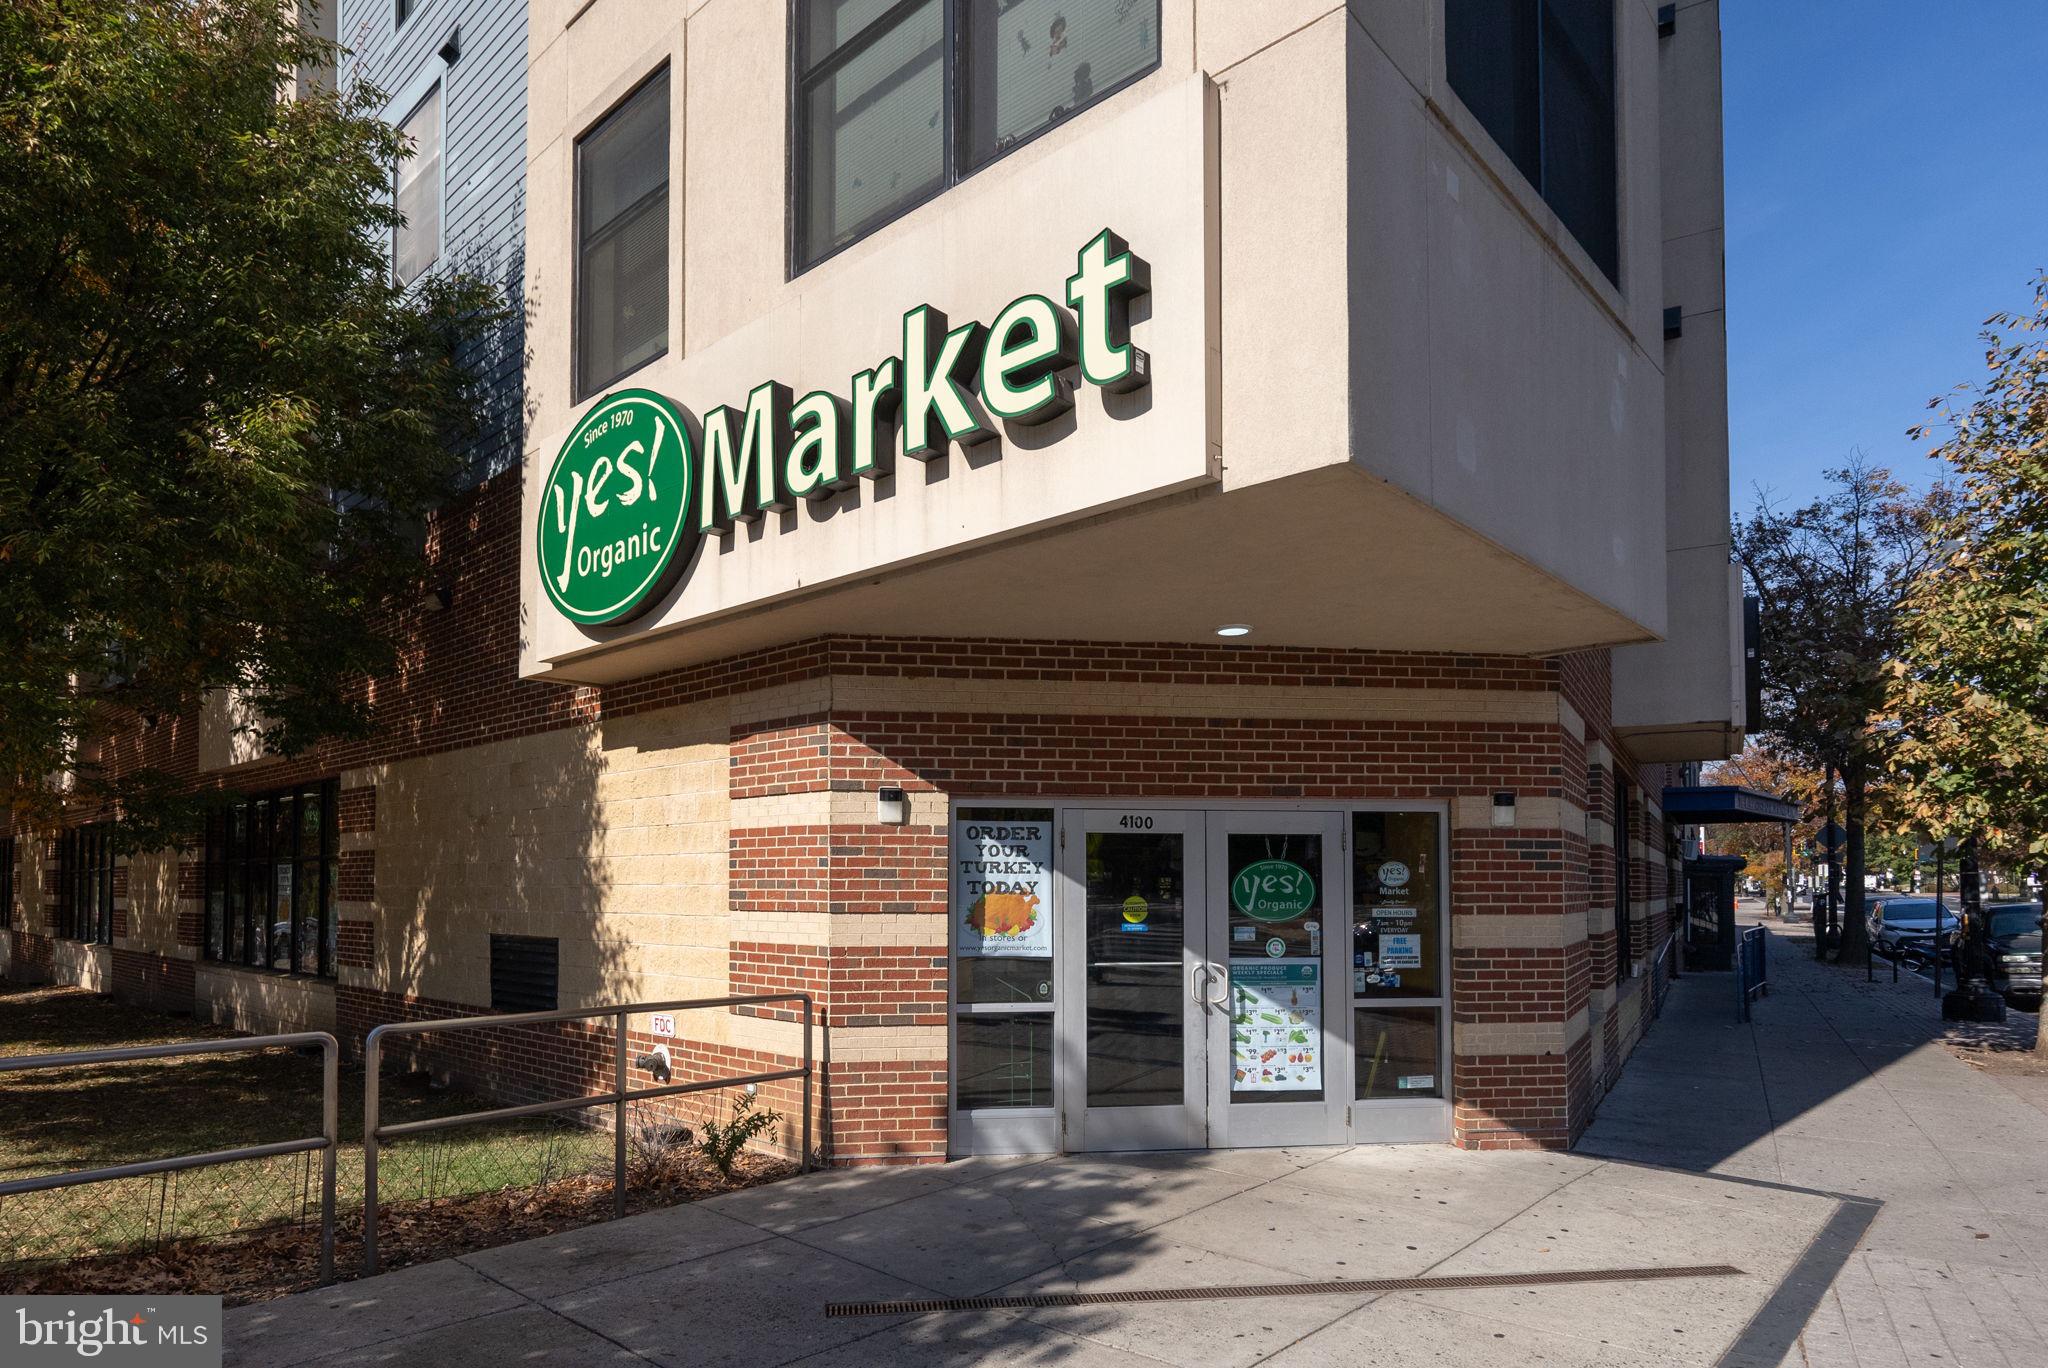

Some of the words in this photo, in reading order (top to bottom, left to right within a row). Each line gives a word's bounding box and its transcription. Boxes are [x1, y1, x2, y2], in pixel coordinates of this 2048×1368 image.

[700, 227, 1138, 534] Market
[584, 418, 608, 448] Since
[610, 410, 634, 429] 1970
[554, 415, 665, 593] yes!
[577, 522, 661, 577] Organic
[1120, 815, 1153, 829] 4100
[966, 826, 1041, 840] ORDER
[975, 844, 1030, 857] YOUR
[960, 860, 1043, 874] TURKEY
[1382, 867, 1405, 881] yes!
[966, 881, 1039, 895] TODAY
[1241, 871, 1303, 912] yes!
[1379, 887, 1409, 895] Market
[1258, 899, 1303, 912] Organic
[989, 934, 1015, 942] stores
[1393, 937, 1407, 945] FREE
[960, 944, 1047, 952] www.yesorganicmarket.com
[1387, 946, 1413, 954] PARKING
[654, 1017, 671, 1033] FDC
